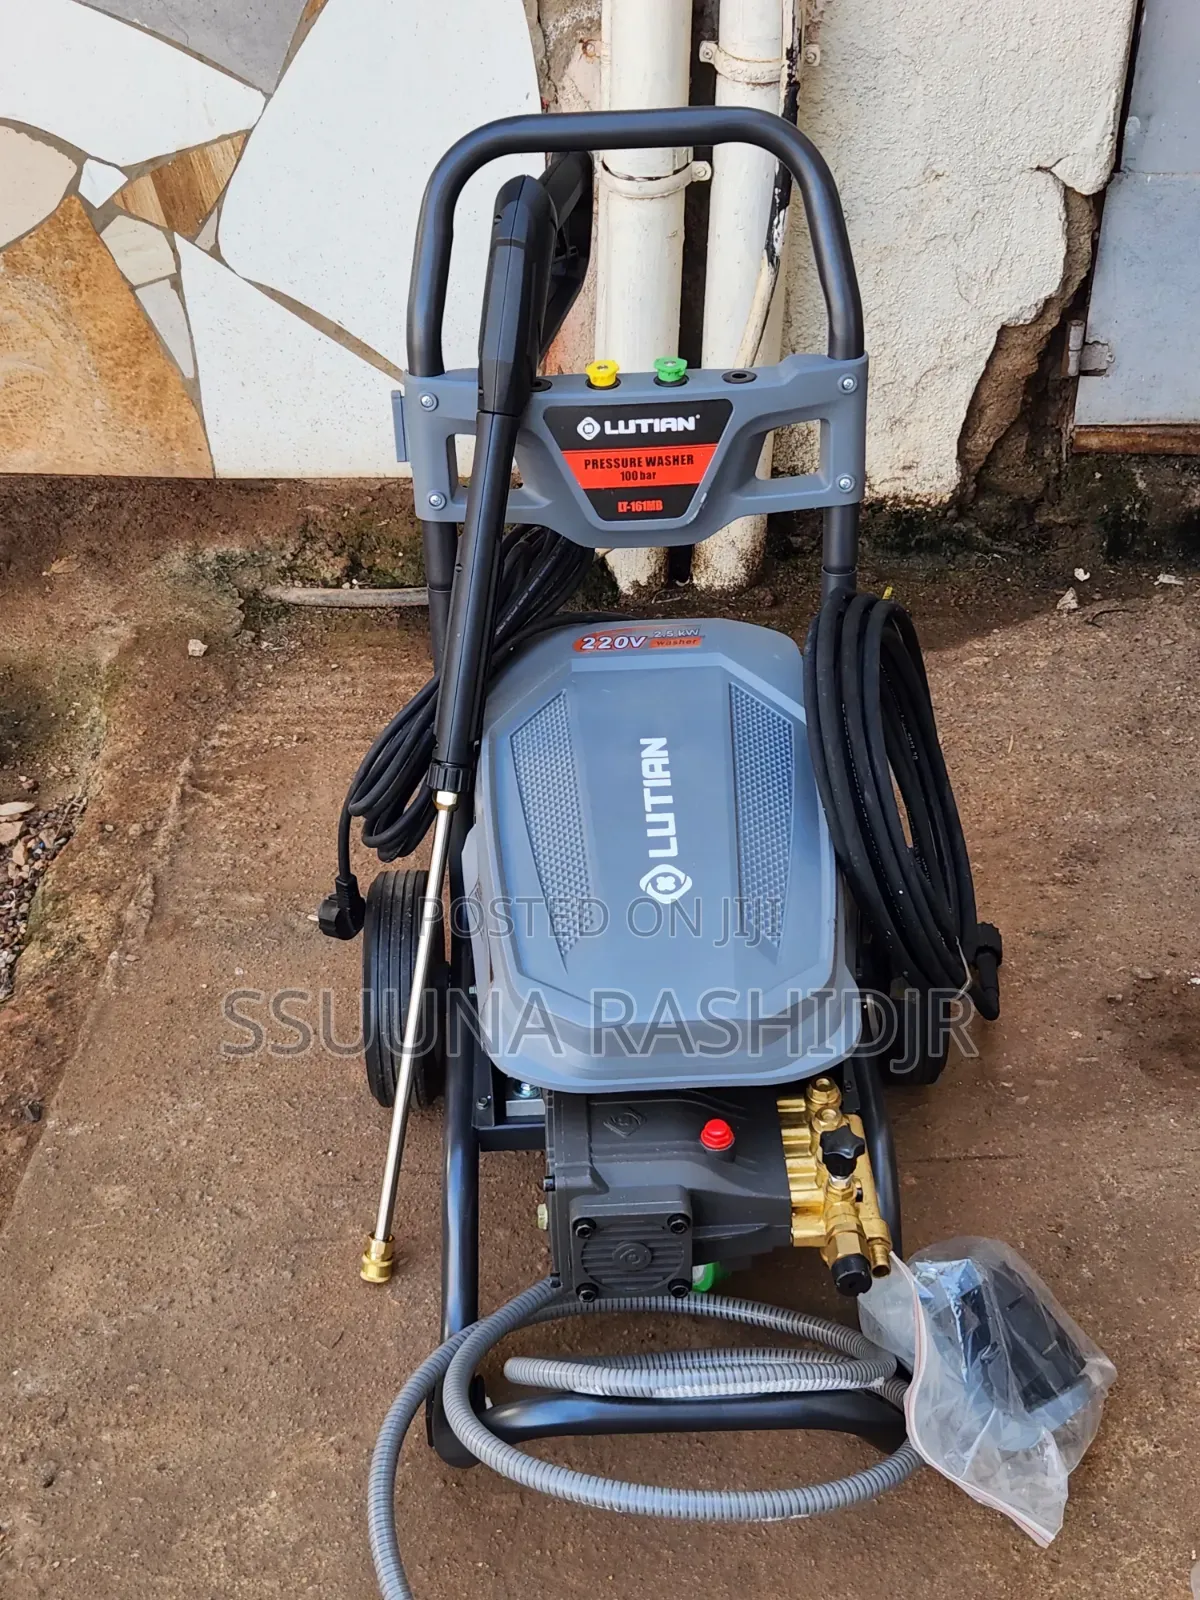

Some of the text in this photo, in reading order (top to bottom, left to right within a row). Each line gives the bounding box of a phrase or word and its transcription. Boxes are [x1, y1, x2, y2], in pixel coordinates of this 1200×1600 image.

[604, 416, 695, 435] LUTIAN
[584, 454, 694, 469] PRESSURE WASHER
[620, 470, 656, 481] 100 bar
[581, 636, 649, 650] 220V
[656, 638, 697, 647] washer
[639, 737, 678, 858] LUTIAN
